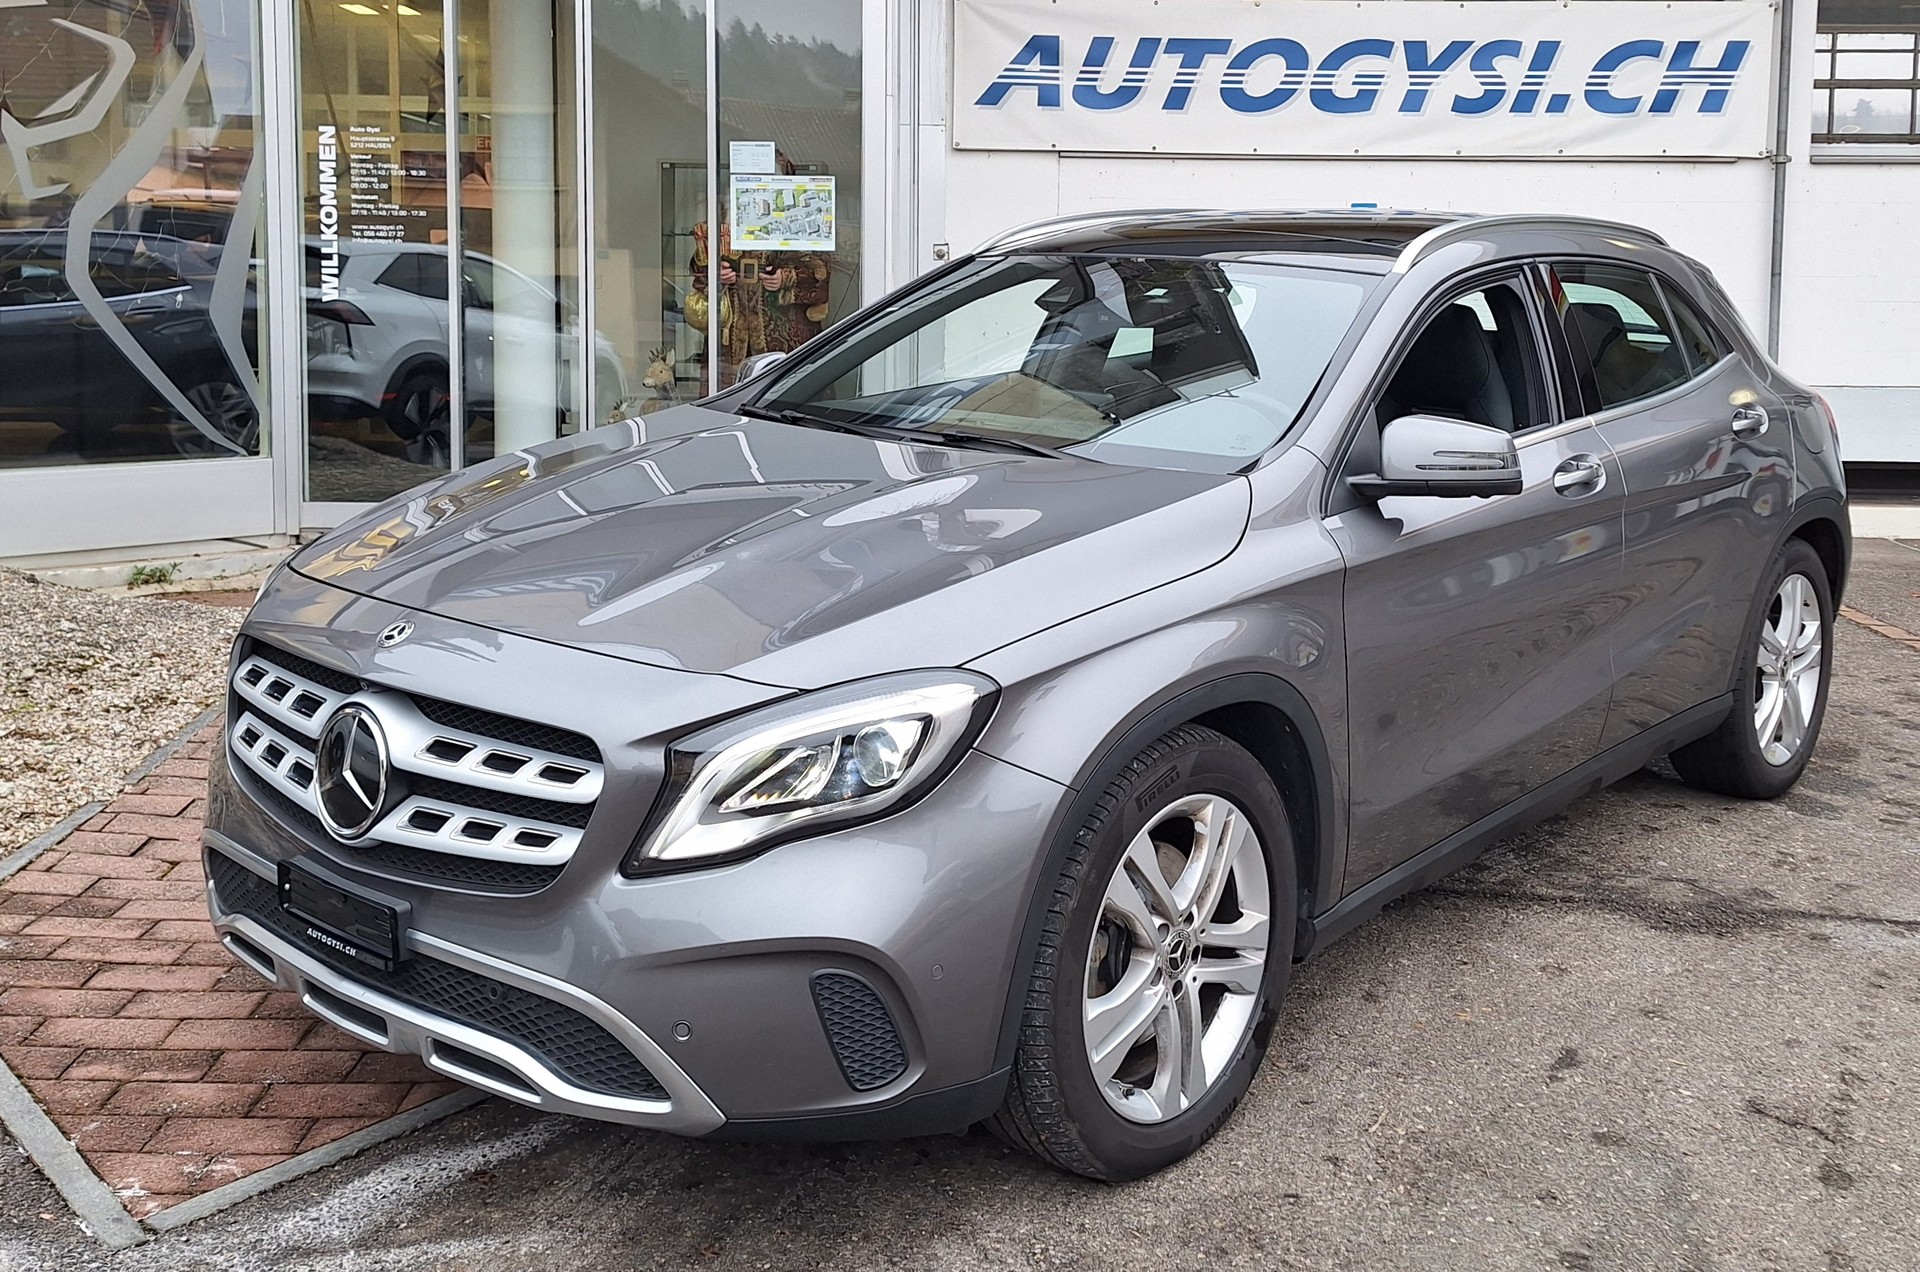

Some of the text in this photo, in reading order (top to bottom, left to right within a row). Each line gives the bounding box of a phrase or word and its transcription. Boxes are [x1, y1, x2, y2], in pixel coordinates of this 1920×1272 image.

[973, 34, 1752, 115] AUTOGYSI.CH
[318, 125, 339, 302] WILLKOMMEN
[1135, 764, 1180, 813] PIRELLI
[306, 927, 356, 957] AUTOGYSI.CH
